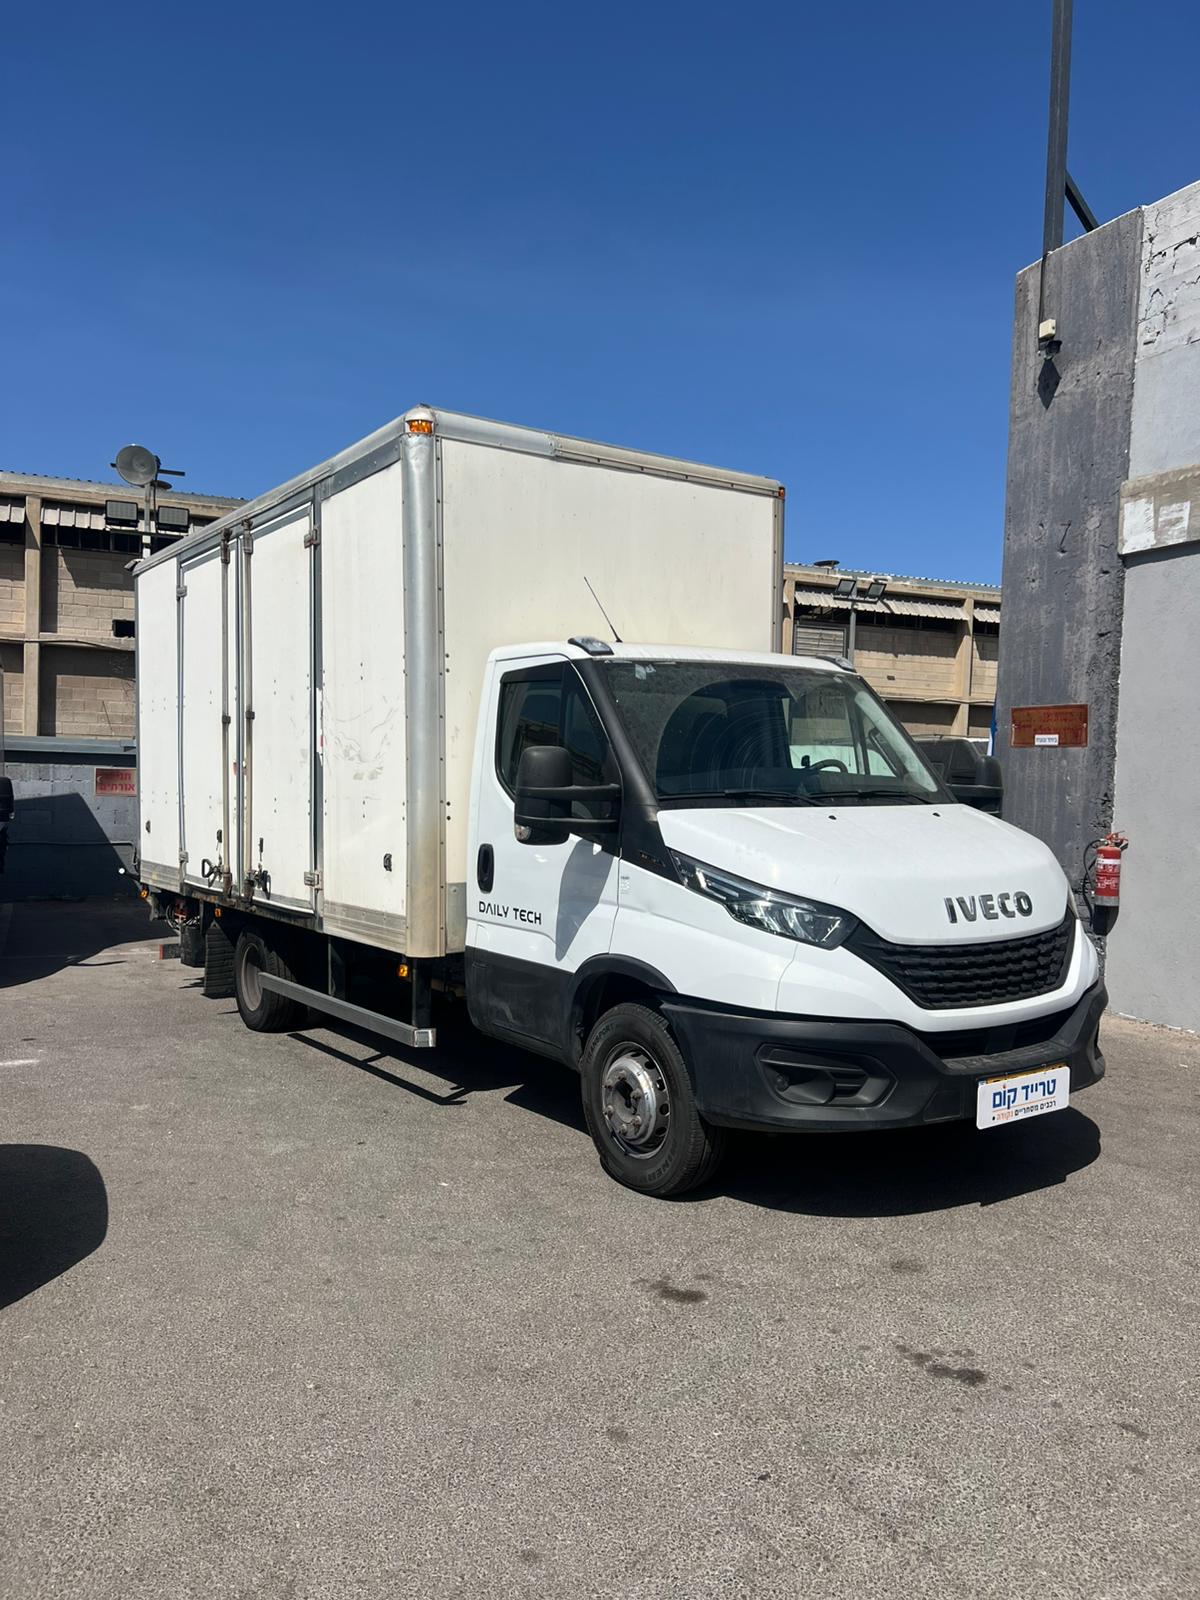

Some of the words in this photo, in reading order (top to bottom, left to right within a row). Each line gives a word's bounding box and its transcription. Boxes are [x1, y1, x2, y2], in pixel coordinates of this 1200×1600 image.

[478, 901, 509, 918] DAILY
[513, 908, 542, 925] TECH
[944, 891, 1033, 924] IVECO
[992, 1087, 1018, 1110] קום
[1021, 1079, 1057, 1101] טרייד
[1014, 1104, 1039, 1116] מסחריים
[1040, 1100, 1057, 1111] רכבים
